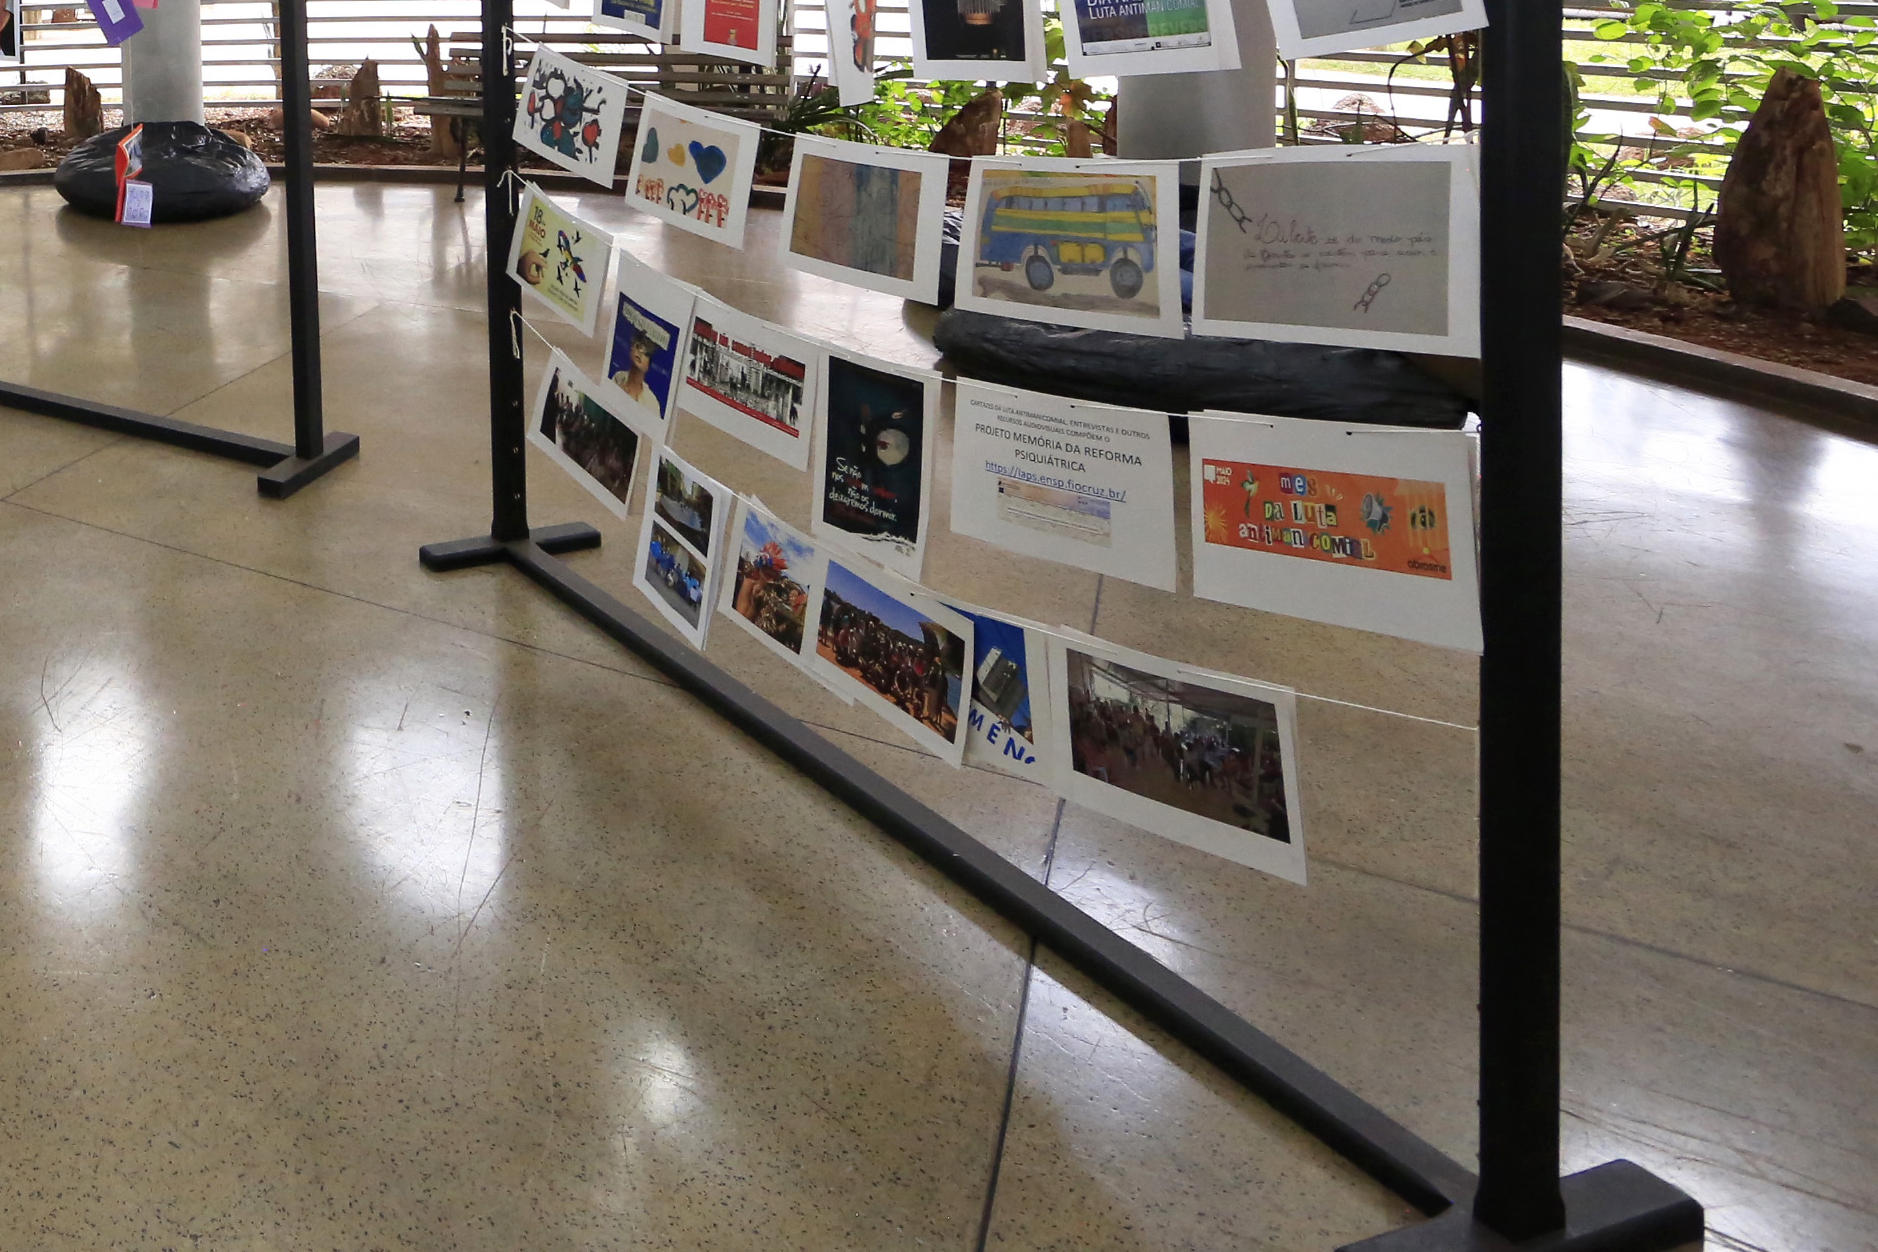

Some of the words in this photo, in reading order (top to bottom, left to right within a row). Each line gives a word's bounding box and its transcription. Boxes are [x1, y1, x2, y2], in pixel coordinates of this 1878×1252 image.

[1089, 6, 1118, 20] LUTA
[534, 206, 544, 224] 18
[970, 399, 994, 410] CARTAZES
[1070, 419, 1114, 434] ENTREVISTAS
[1121, 429, 1151, 439] OUTROS
[997, 415, 1023, 426] RECURSOS
[1023, 421, 1065, 435] AUDIOVISUAIS
[1066, 429, 1103, 441] COMPÕEM
[975, 423, 1011, 440] PROJETO
[1013, 432, 1063, 450] MEMÓRIA
[1065, 443, 1081, 455] DA
[1084, 446, 1143, 466] REFORMA
[835, 456, 848, 473] Se
[849, 465, 862, 479] não
[1015, 449, 1086, 472] PSIQUIÁTRICA
[832, 471, 844, 483] nos
[985, 460, 1127, 502] https://laps.ensp.fiocruz.br/
[848, 486, 860, 499] não
[861, 495, 870, 505] os
